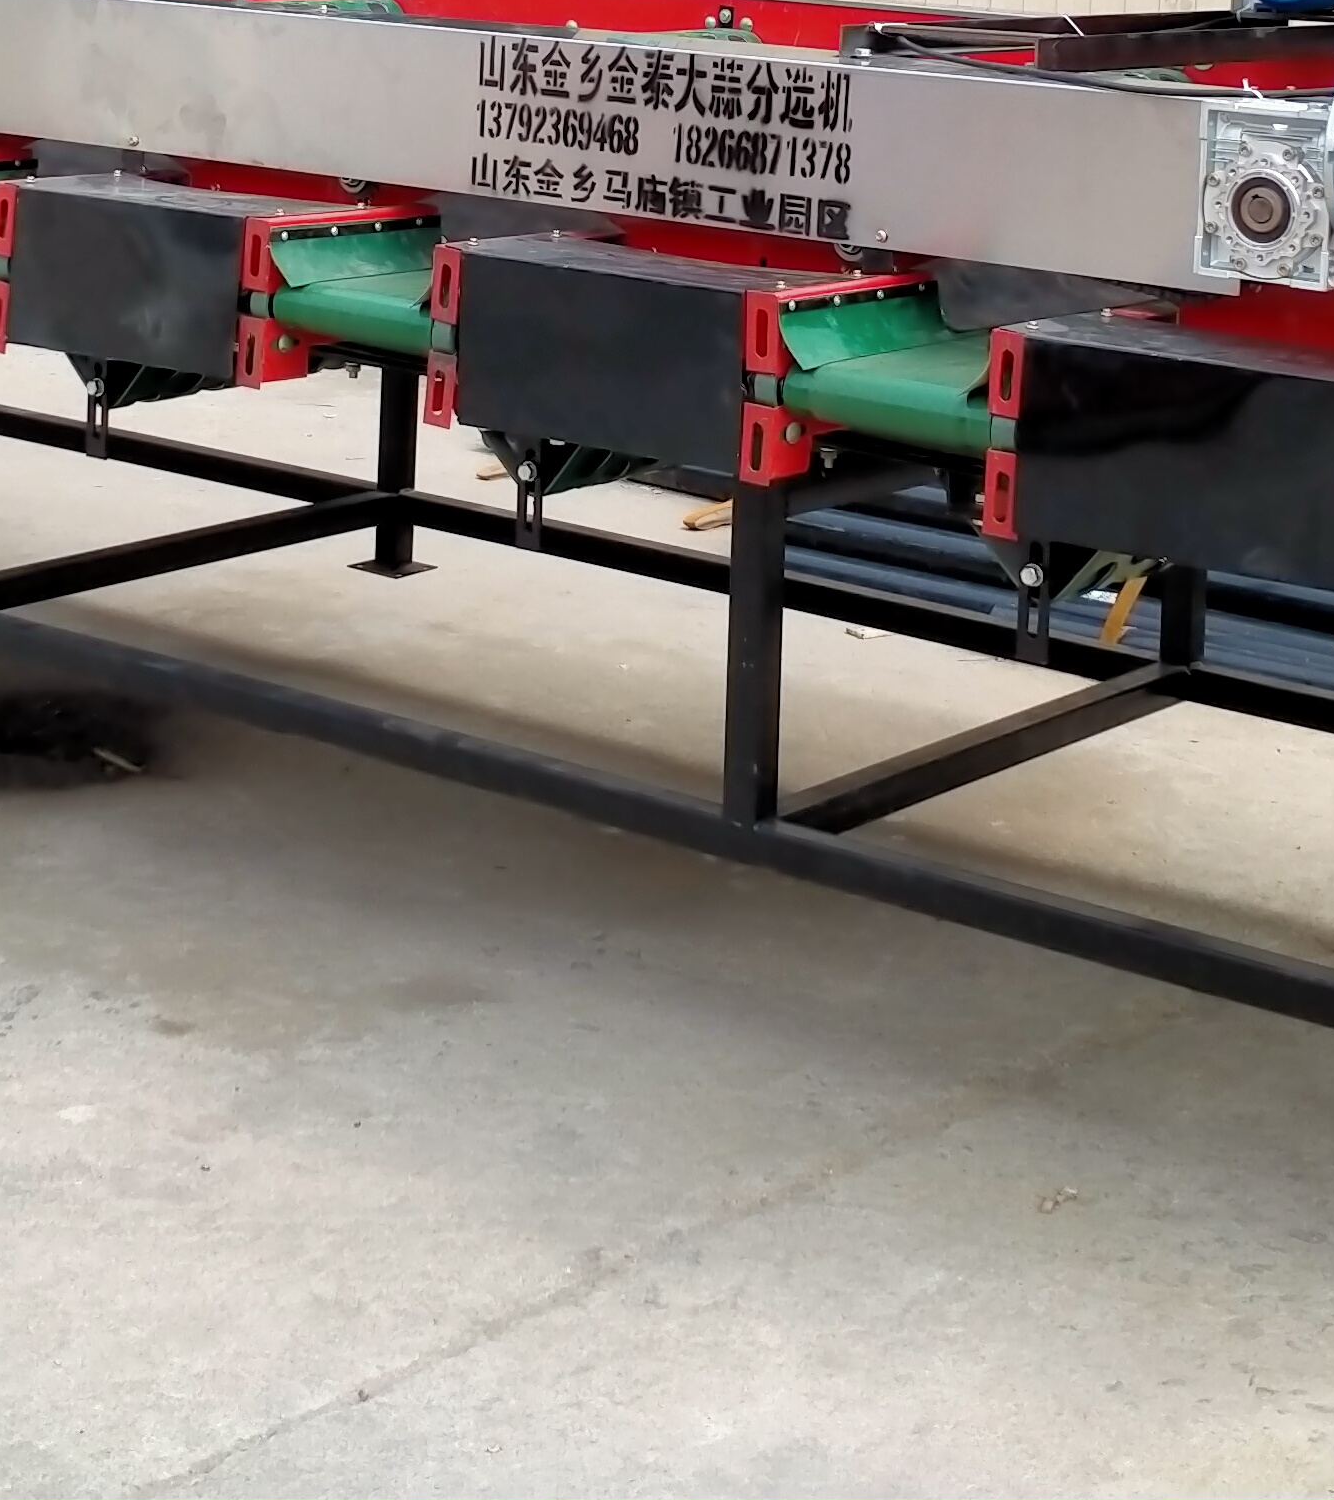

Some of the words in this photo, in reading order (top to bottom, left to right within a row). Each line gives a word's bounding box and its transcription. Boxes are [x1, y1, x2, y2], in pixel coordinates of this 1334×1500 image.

[479, 35, 851, 132] 山东金乡金泰大蒜分选机
[477, 99, 639, 155] 13792369468
[673, 122, 851, 184] 18266871378
[472, 152, 851, 240] 山东金乡马庙镇工业园区
